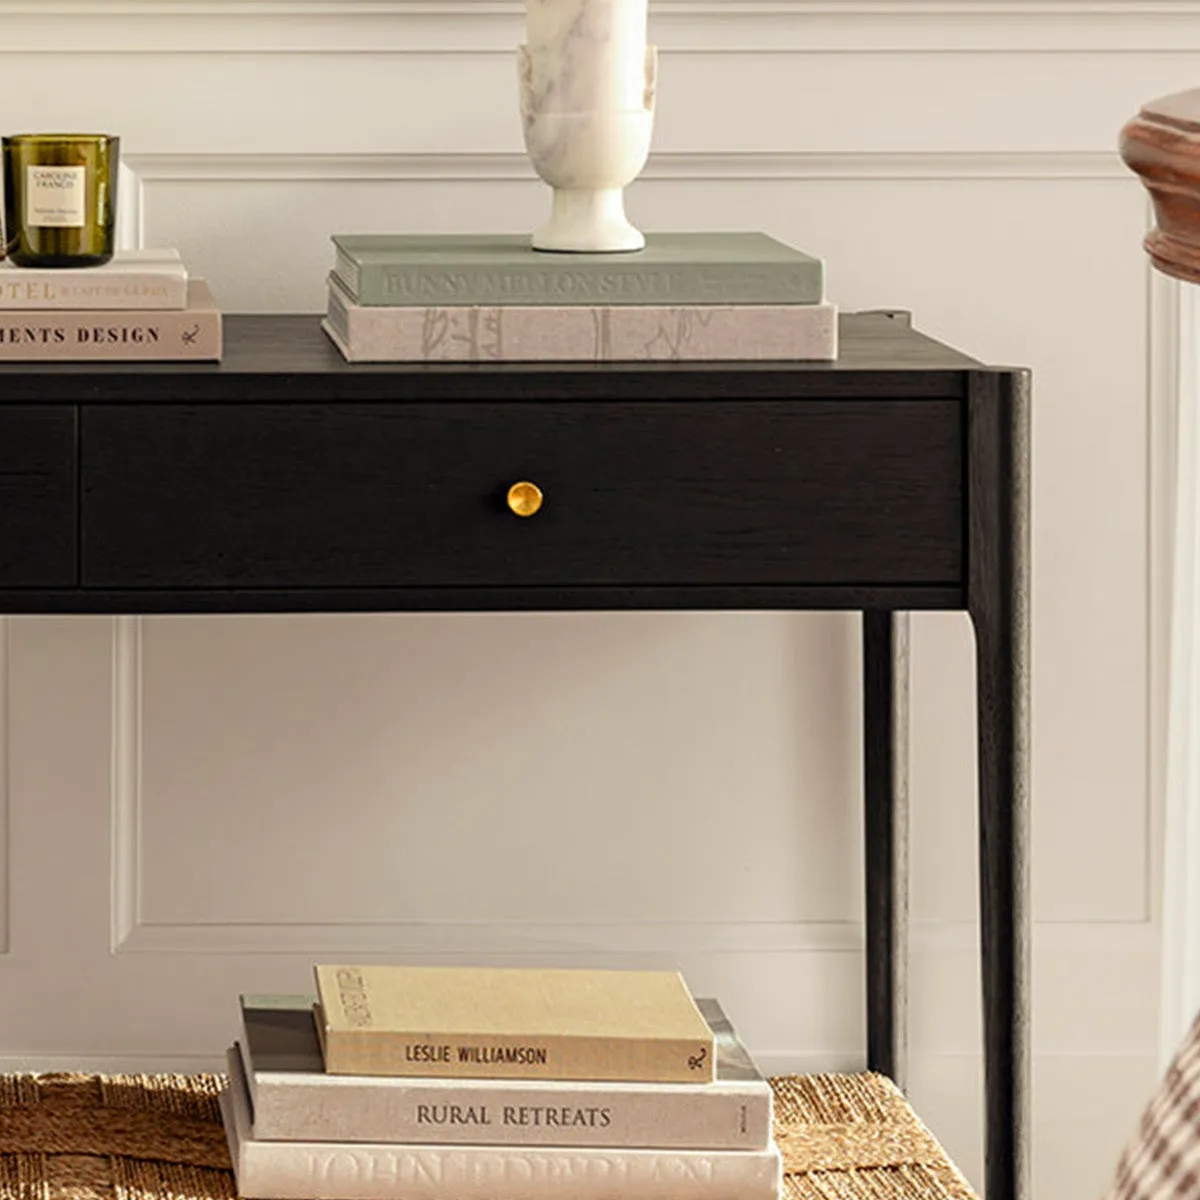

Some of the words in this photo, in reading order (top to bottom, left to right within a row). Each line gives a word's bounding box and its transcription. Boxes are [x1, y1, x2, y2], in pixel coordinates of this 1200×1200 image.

[77, 327, 161, 344] DESIGN
[405, 1044, 451, 1063] LESLIE
[457, 1046, 548, 1065] WILLIAMSON
[416, 1104, 492, 1125] RURAL
[502, 1105, 612, 1128] RETREATS
